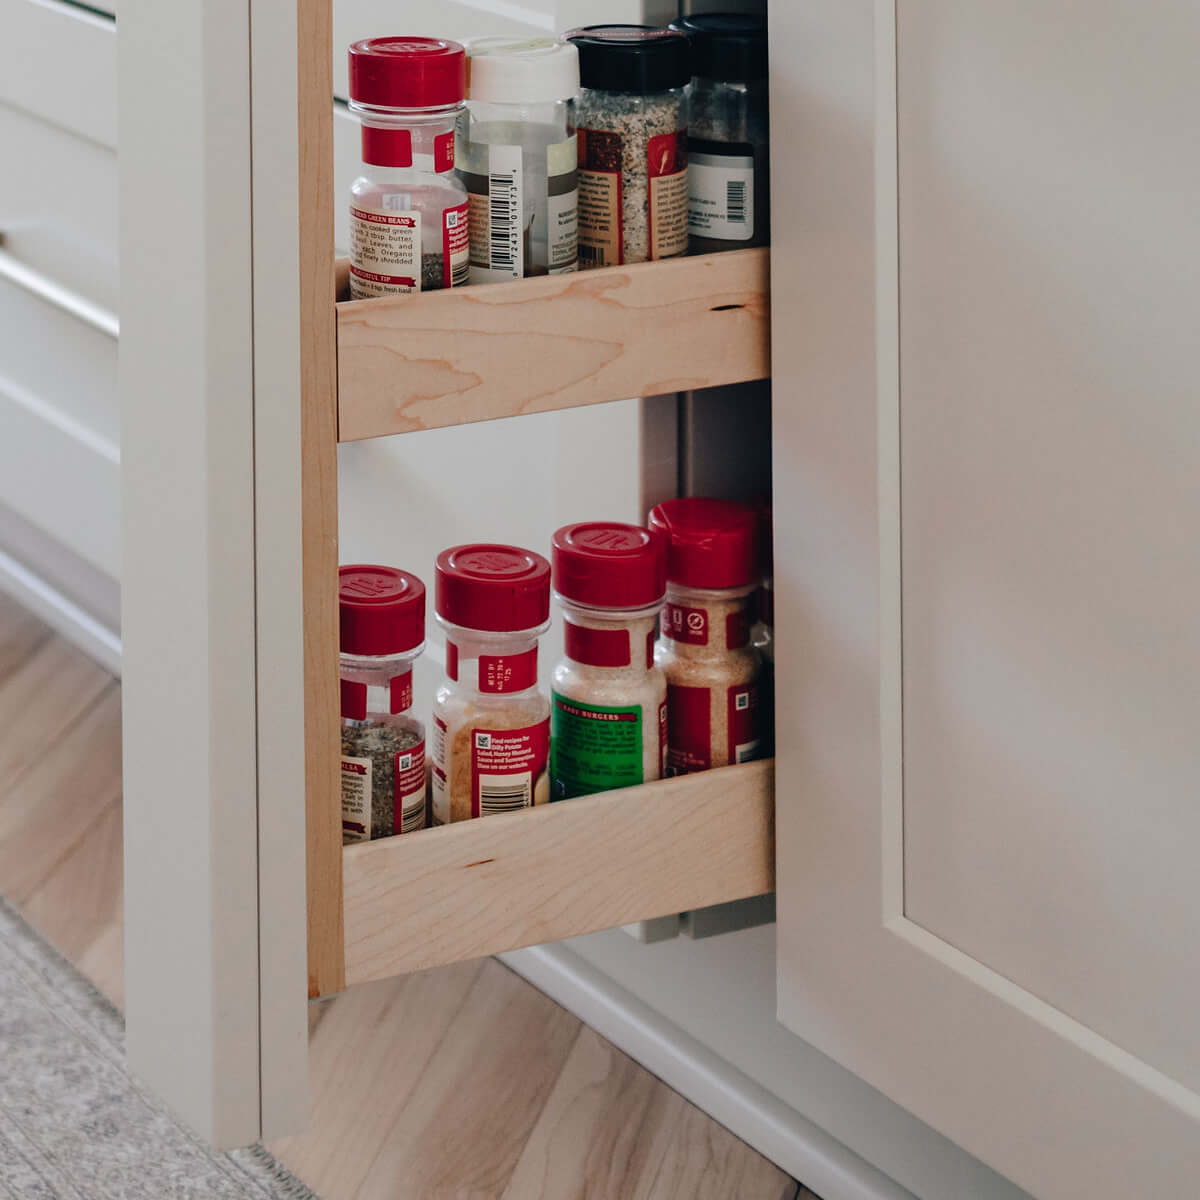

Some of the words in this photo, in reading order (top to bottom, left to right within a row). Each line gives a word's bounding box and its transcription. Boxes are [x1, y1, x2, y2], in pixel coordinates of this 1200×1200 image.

[388, 216, 410, 225] BEANS
[510, 226, 518, 259] 72431
[381, 249, 413, 257] Oregano
[381, 257, 413, 265] shredded
[581, 710, 619, 721] BURGERS
